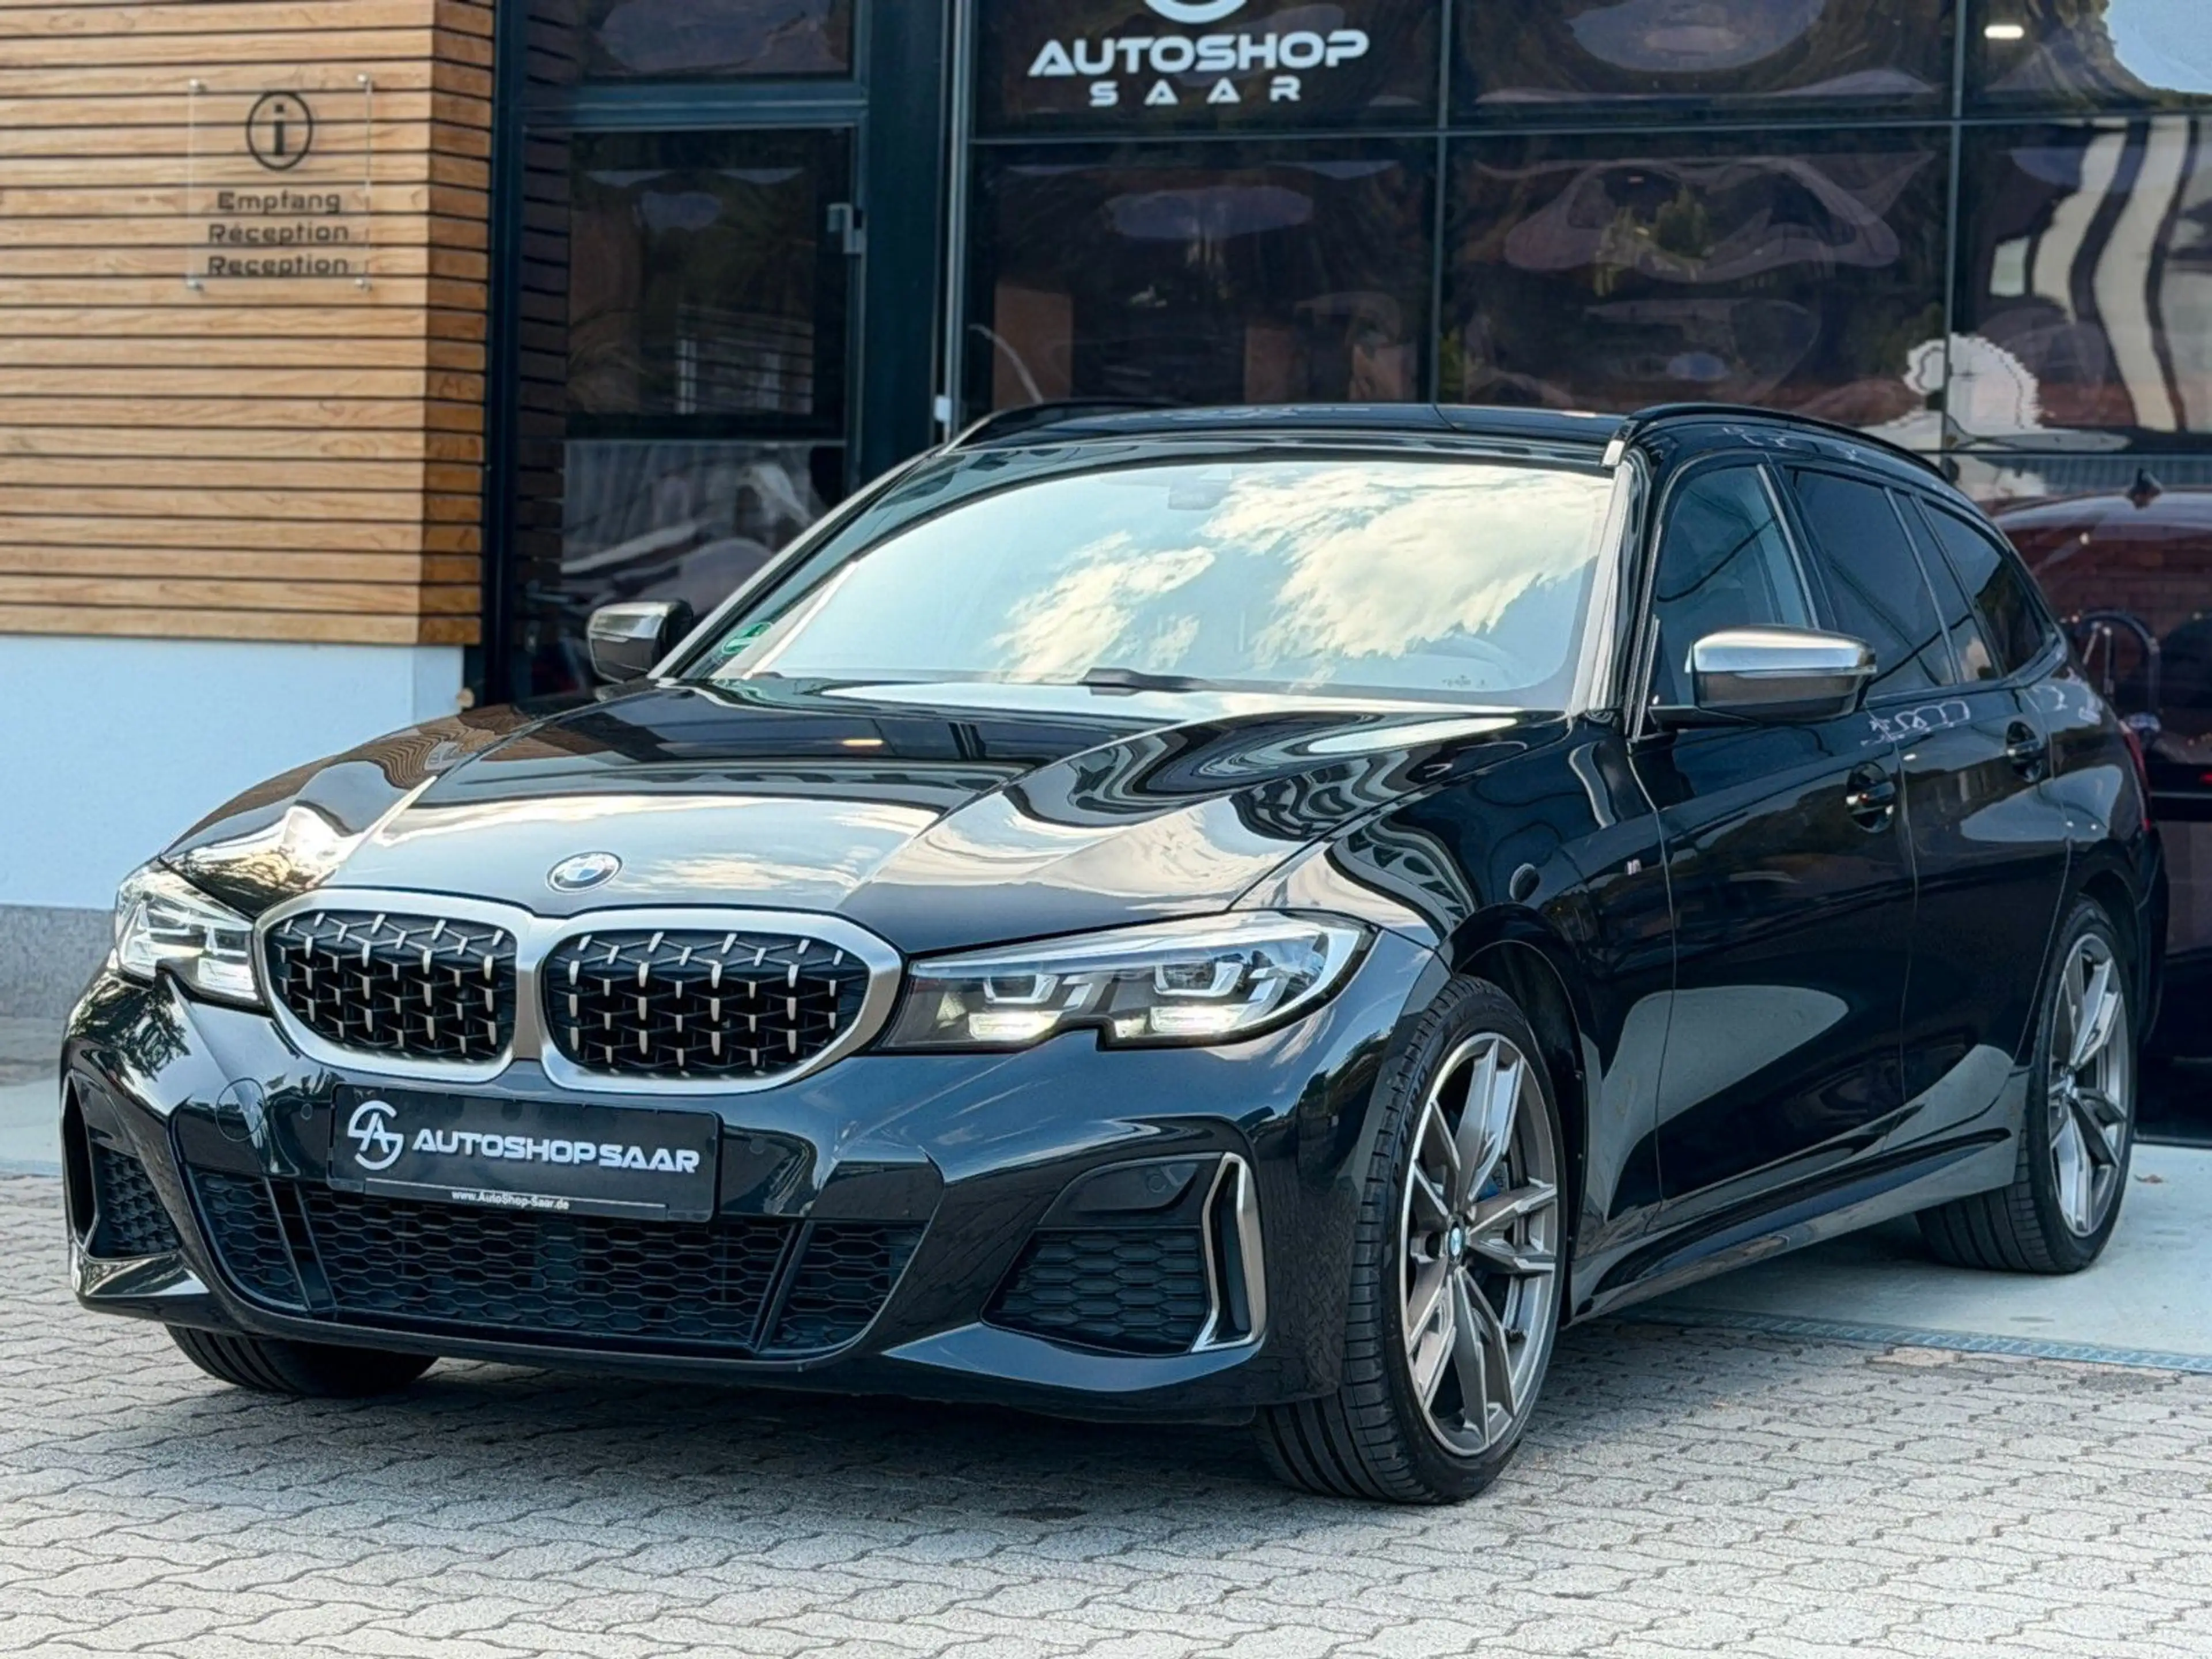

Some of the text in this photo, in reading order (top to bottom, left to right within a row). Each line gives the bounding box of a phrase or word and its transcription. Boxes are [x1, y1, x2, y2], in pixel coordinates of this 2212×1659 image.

[1028, 29, 1369, 77] AUTOSHOP
[217, 190, 341, 214] Empfang
[208, 254, 349, 276] Reception
